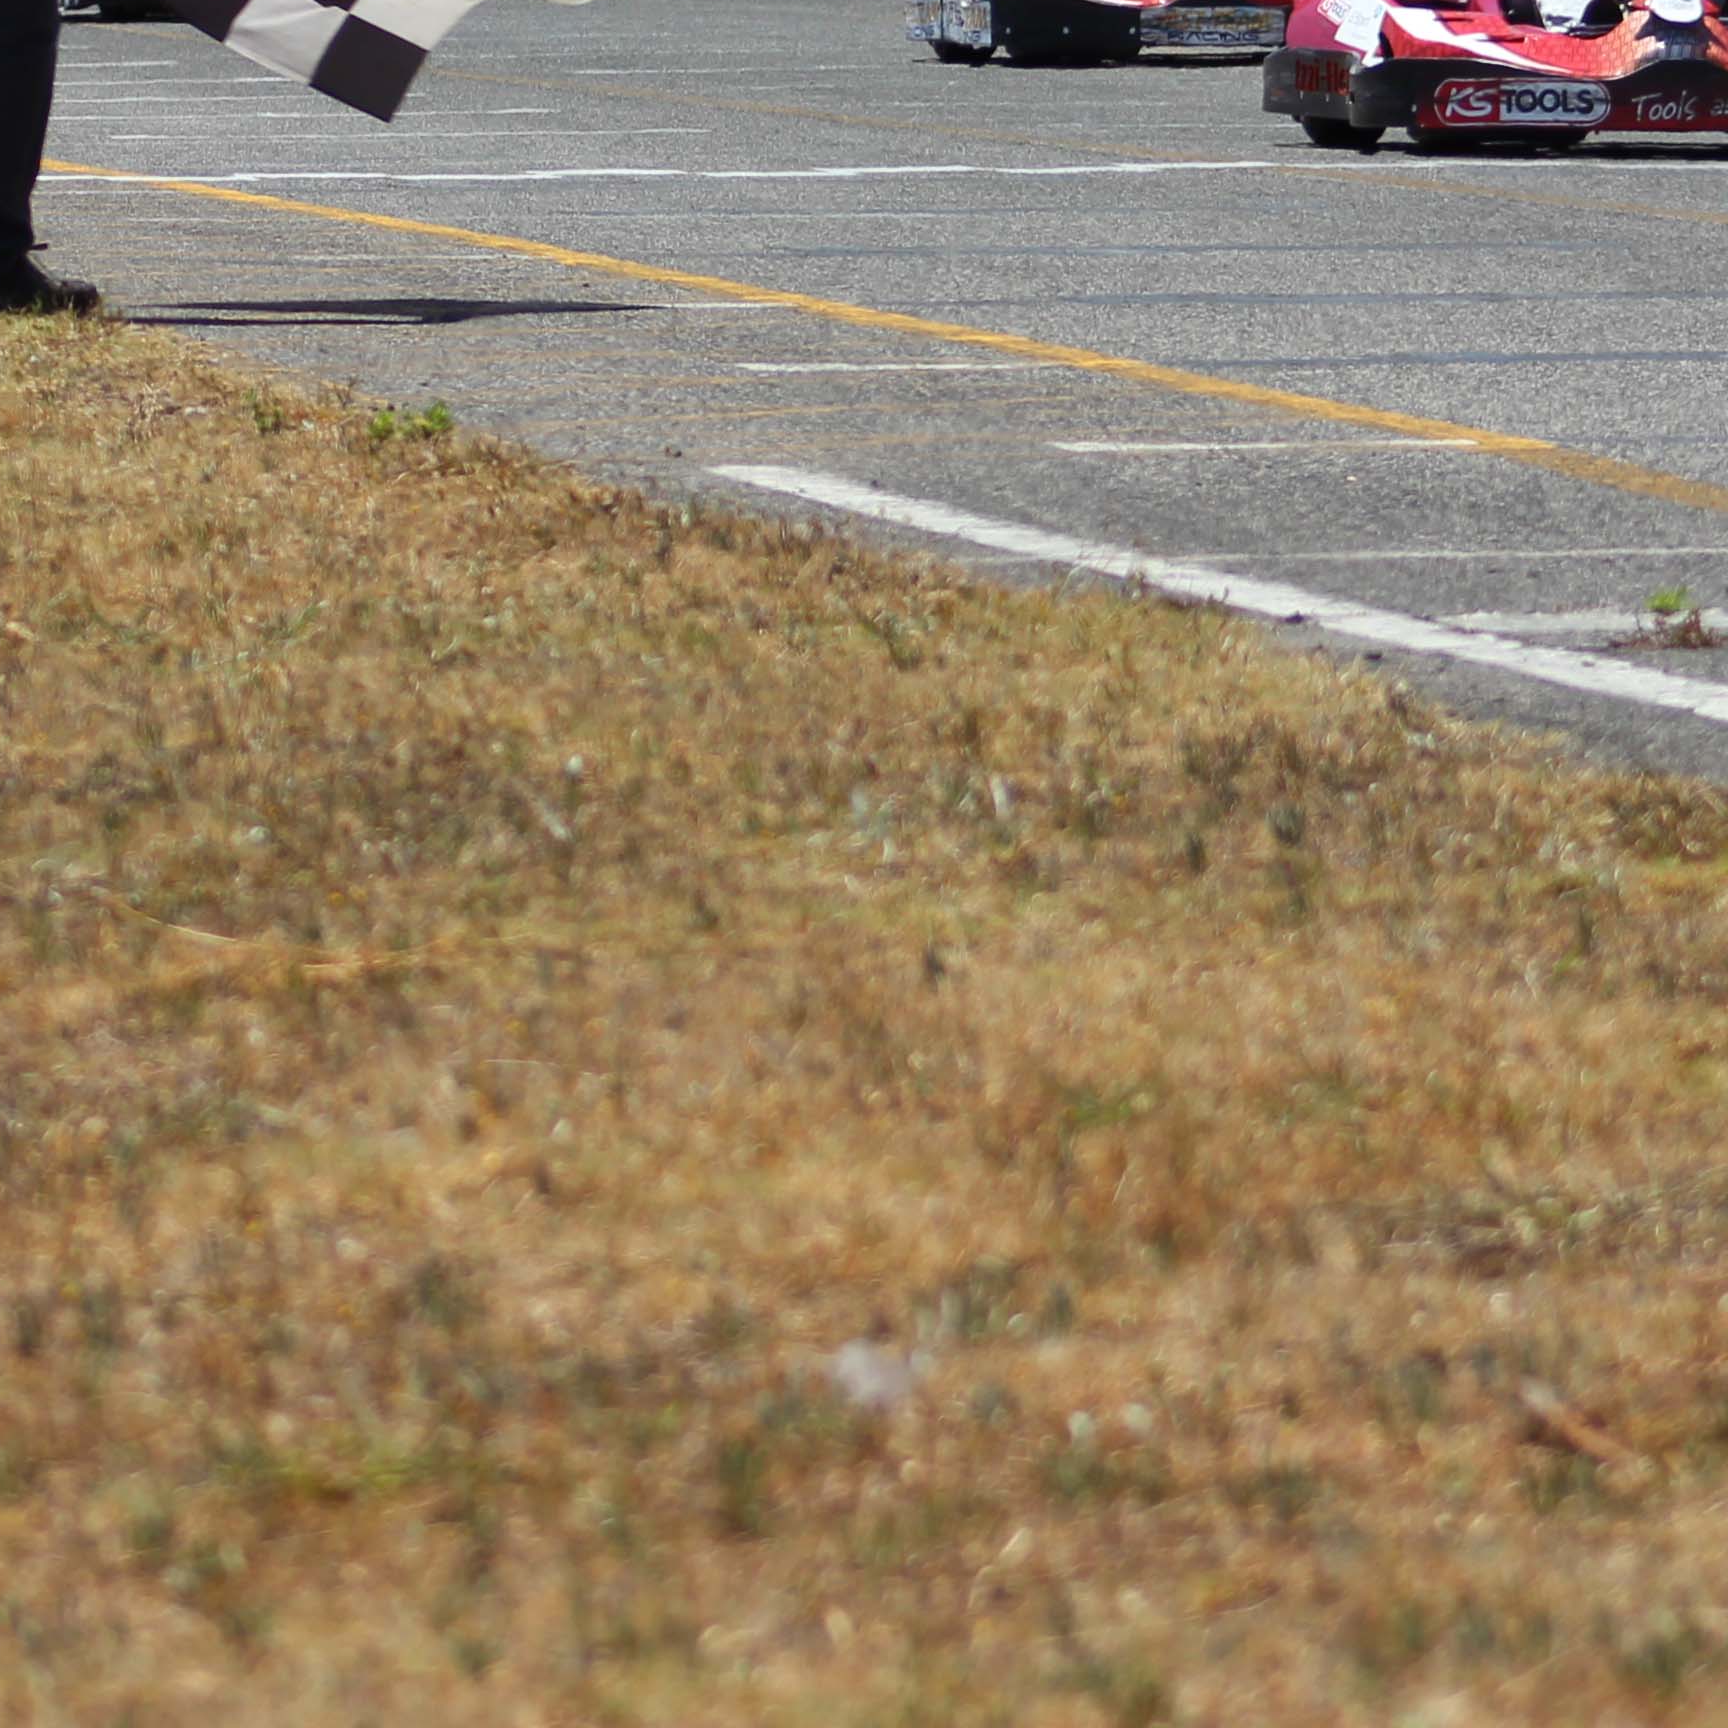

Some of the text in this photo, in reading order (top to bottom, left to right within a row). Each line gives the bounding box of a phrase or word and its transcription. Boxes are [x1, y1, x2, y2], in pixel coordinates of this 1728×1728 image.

[1445, 88, 1595, 119] KS TOOLS
[1632, 91, 1696, 122] Tools
